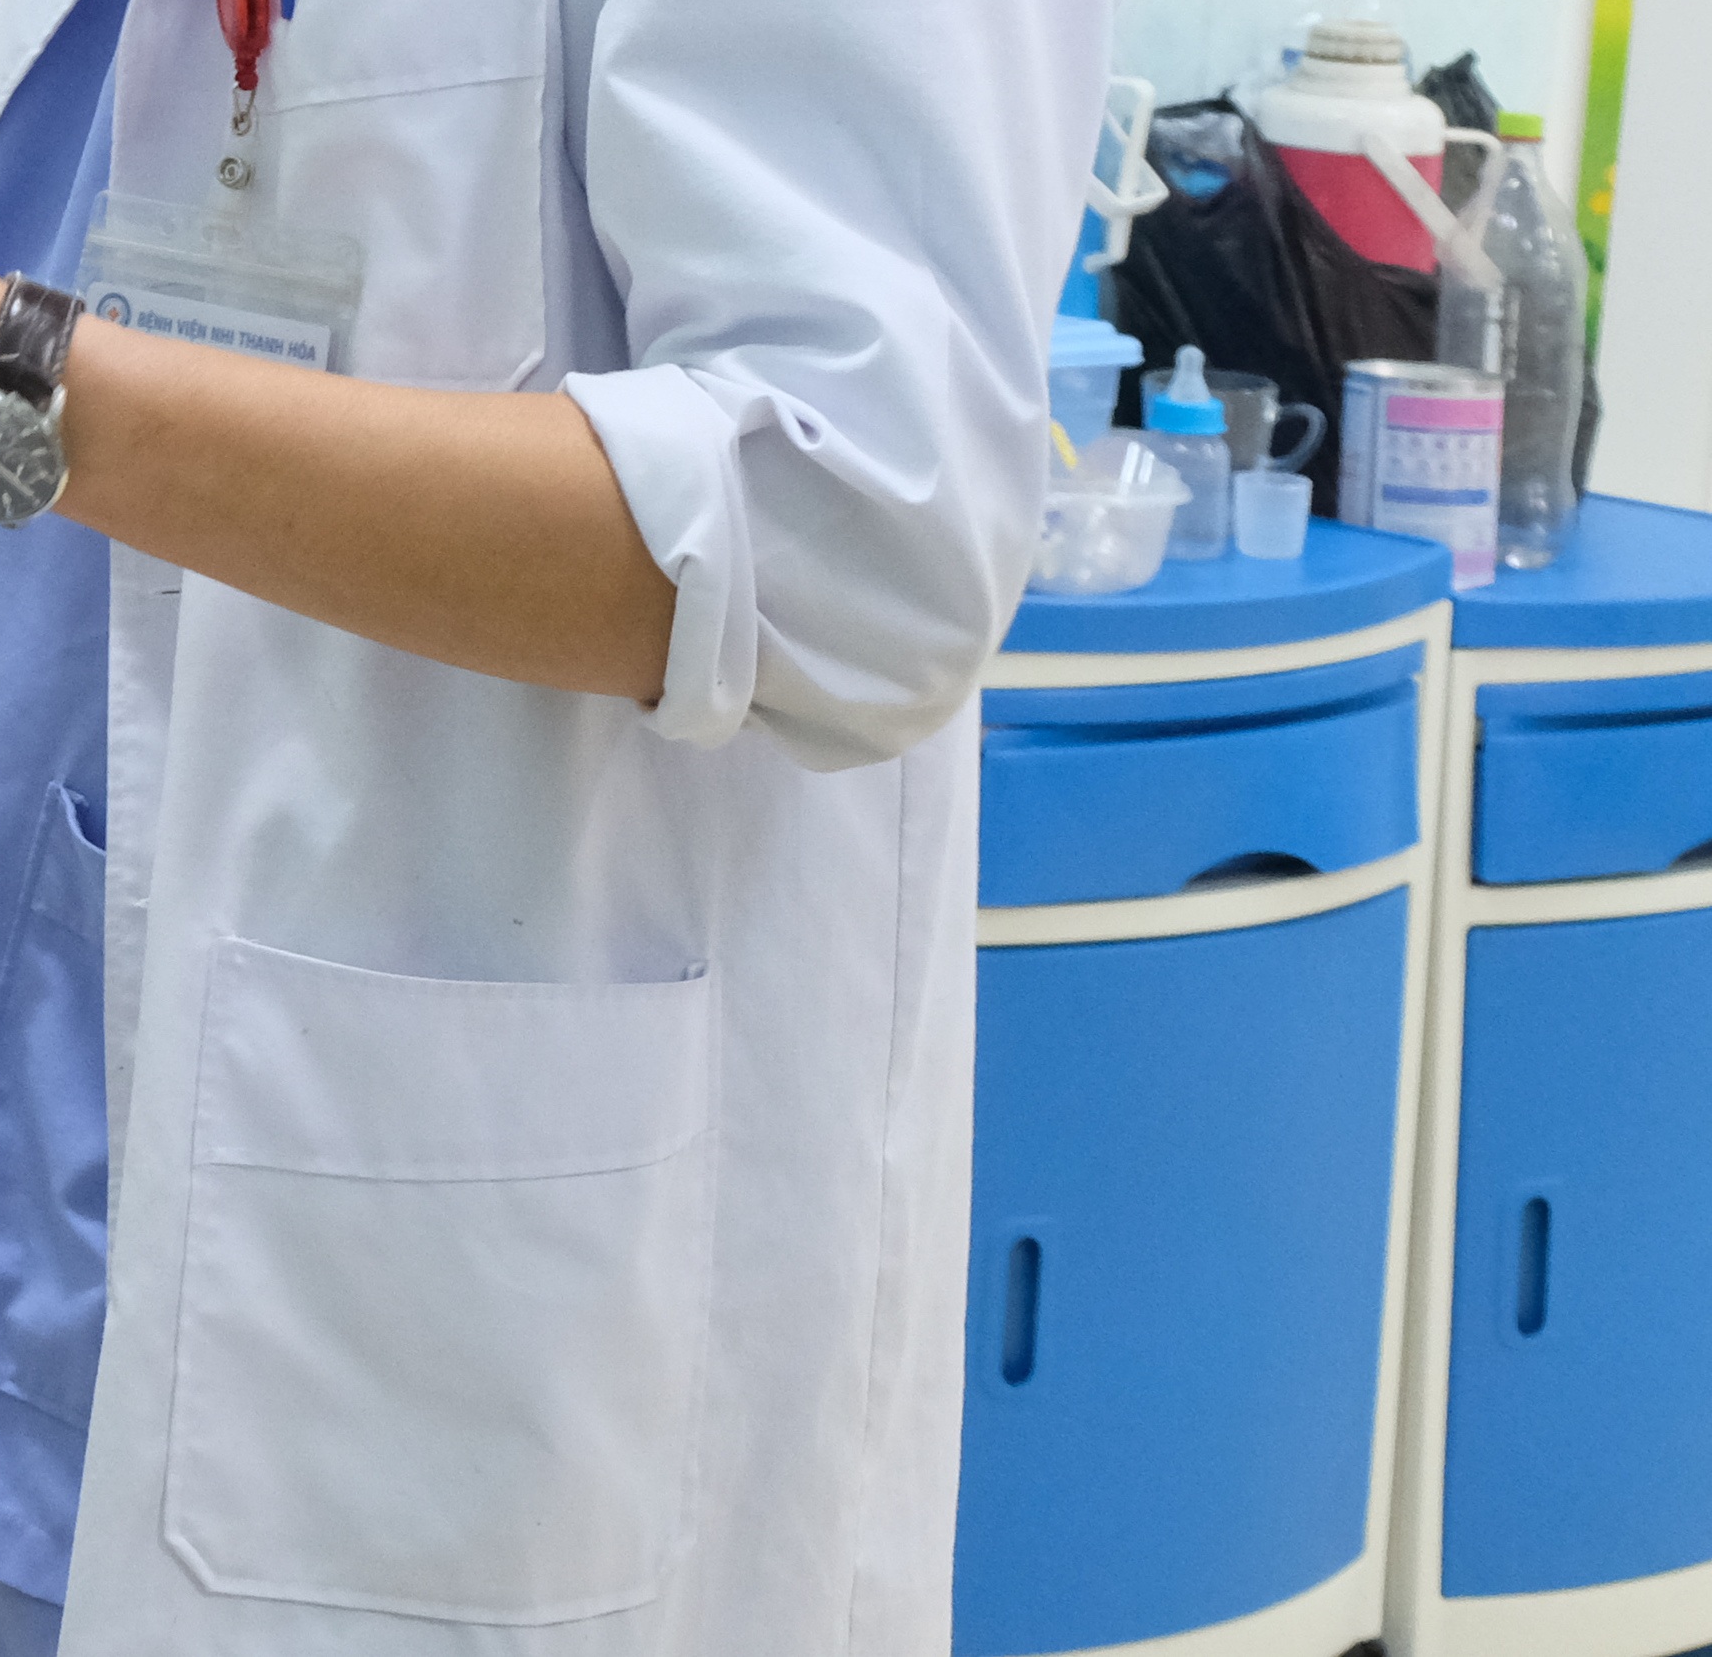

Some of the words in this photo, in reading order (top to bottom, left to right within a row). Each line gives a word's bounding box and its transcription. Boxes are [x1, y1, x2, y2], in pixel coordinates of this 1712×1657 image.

[137, 309, 173, 333] BỆNH
[177, 318, 207, 342] VIỆN
[211, 326, 235, 345] NHI
[239, 330, 284, 356] THANH
